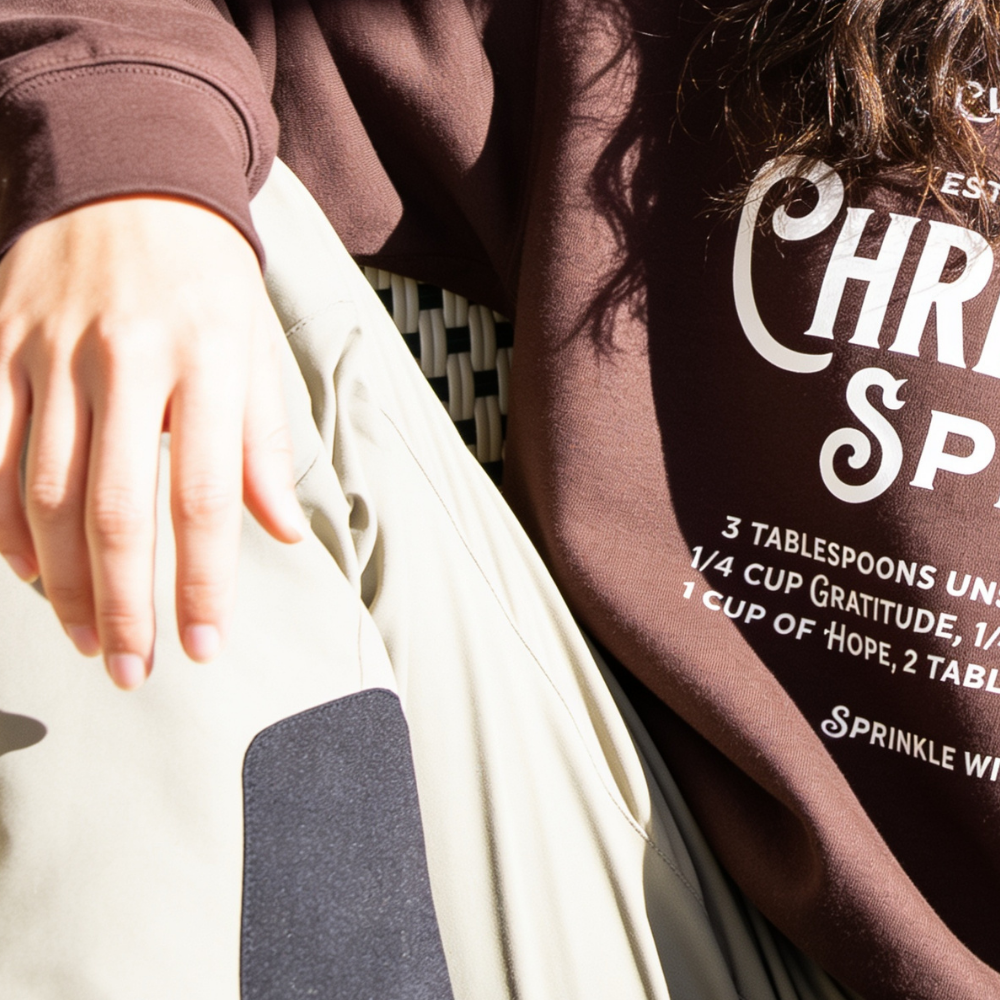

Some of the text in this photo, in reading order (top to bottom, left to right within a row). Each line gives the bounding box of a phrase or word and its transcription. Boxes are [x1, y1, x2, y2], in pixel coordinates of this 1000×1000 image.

[690, 546, 735, 578] 1/4
[743, 563, 804, 594] CUP
[721, 515, 742, 539] 3
[751, 522, 936, 590] TABLESPOONS
[682, 581, 696, 600] 1
[702, 590, 767, 624] CUP
[773, 612, 817, 641] OF
[902, 649, 918, 675] 2
